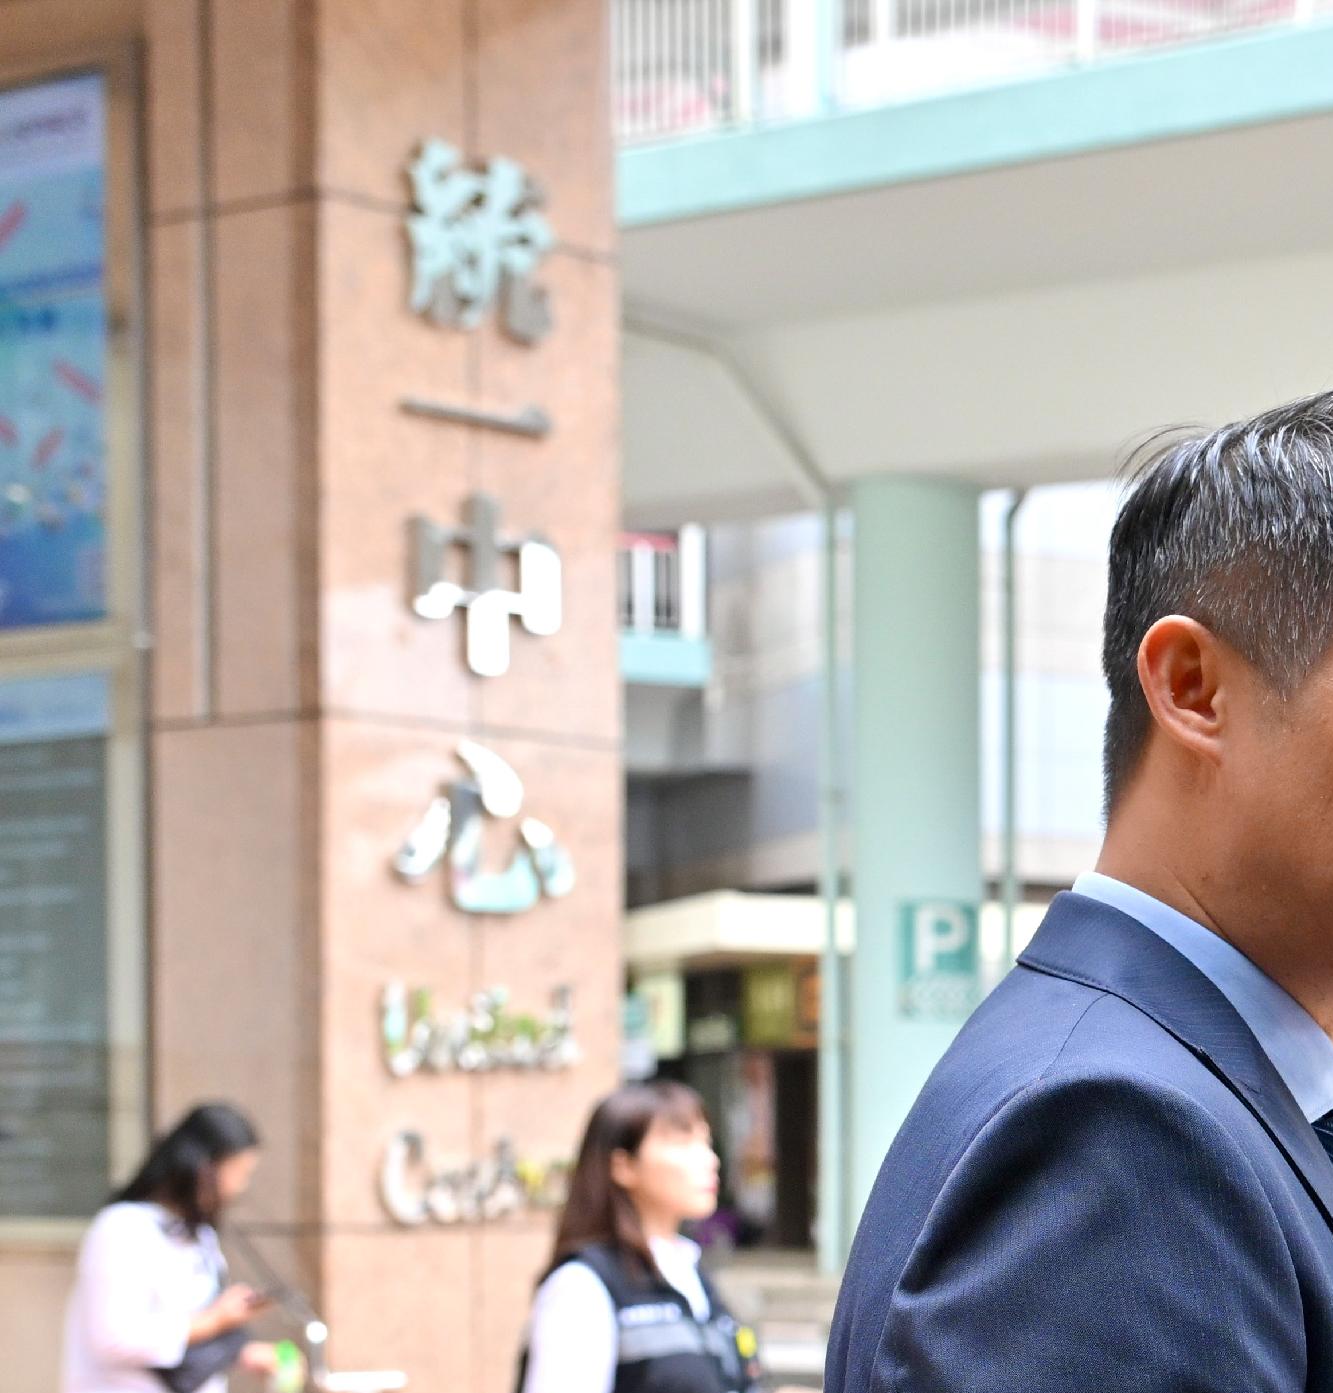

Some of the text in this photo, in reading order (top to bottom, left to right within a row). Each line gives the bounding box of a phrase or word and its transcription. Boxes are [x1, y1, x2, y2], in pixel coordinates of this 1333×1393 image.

[398, 138, 576, 914] 統一中心
[914, 903, 968, 973] P
